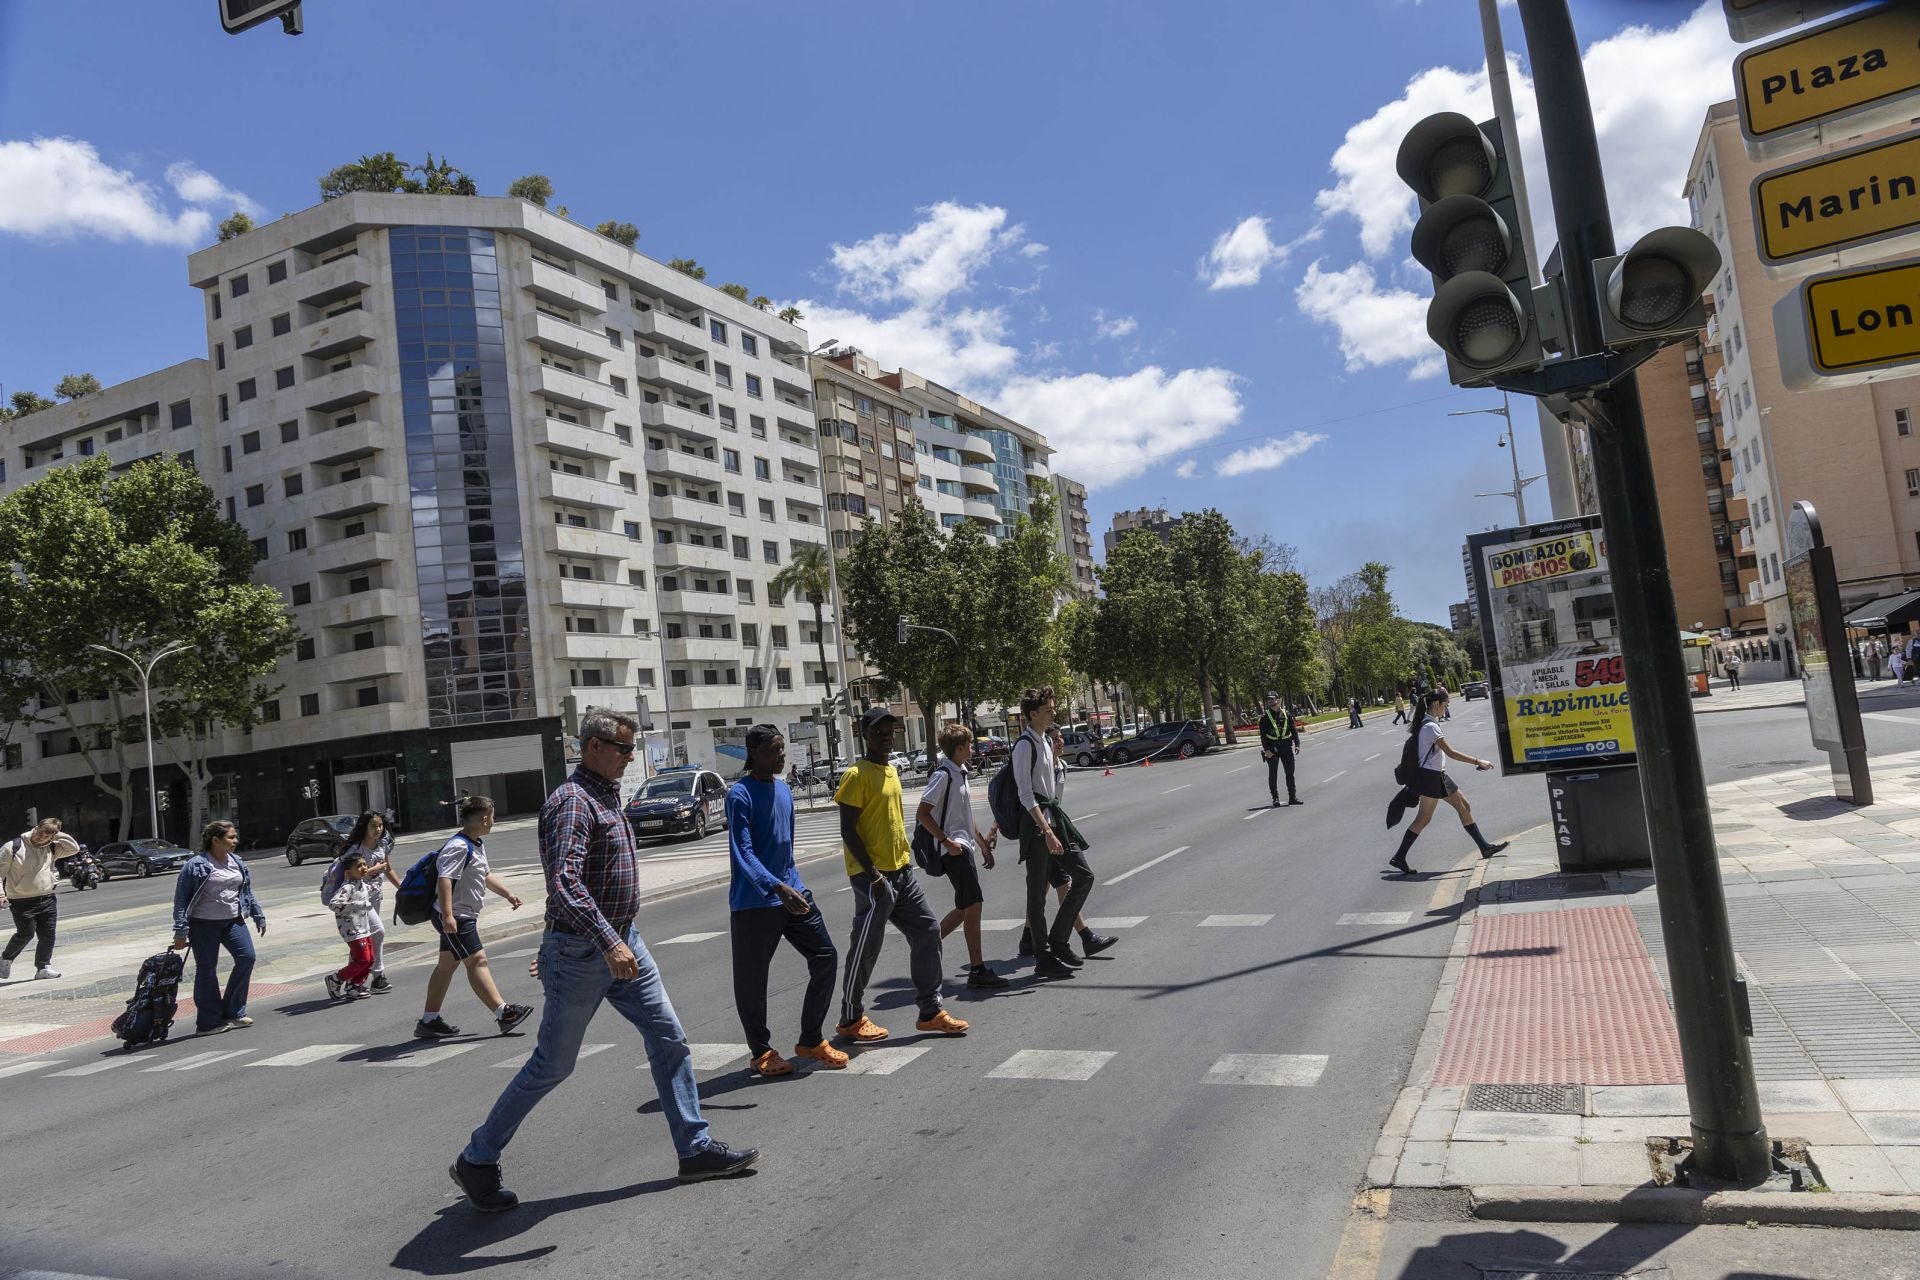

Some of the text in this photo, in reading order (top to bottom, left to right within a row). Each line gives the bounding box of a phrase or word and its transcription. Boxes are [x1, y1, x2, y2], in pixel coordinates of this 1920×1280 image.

[1761, 48, 1888, 105] Plaza
[1779, 175, 1917, 230] Marin
[1830, 303, 1913, 338] Lon
[1491, 541, 1567, 571] BOMBAZO
[1568, 538, 1581, 550] DE
[1502, 556, 1569, 585] PRECIOS
[1531, 666, 1565, 676] APILABLE
[1546, 679, 1570, 689] SILLAS
[1516, 690, 1630, 718] Rapimue
[1553, 733, 1585, 741] CARTAGENA
[1552, 788, 1572, 846] PILAS
